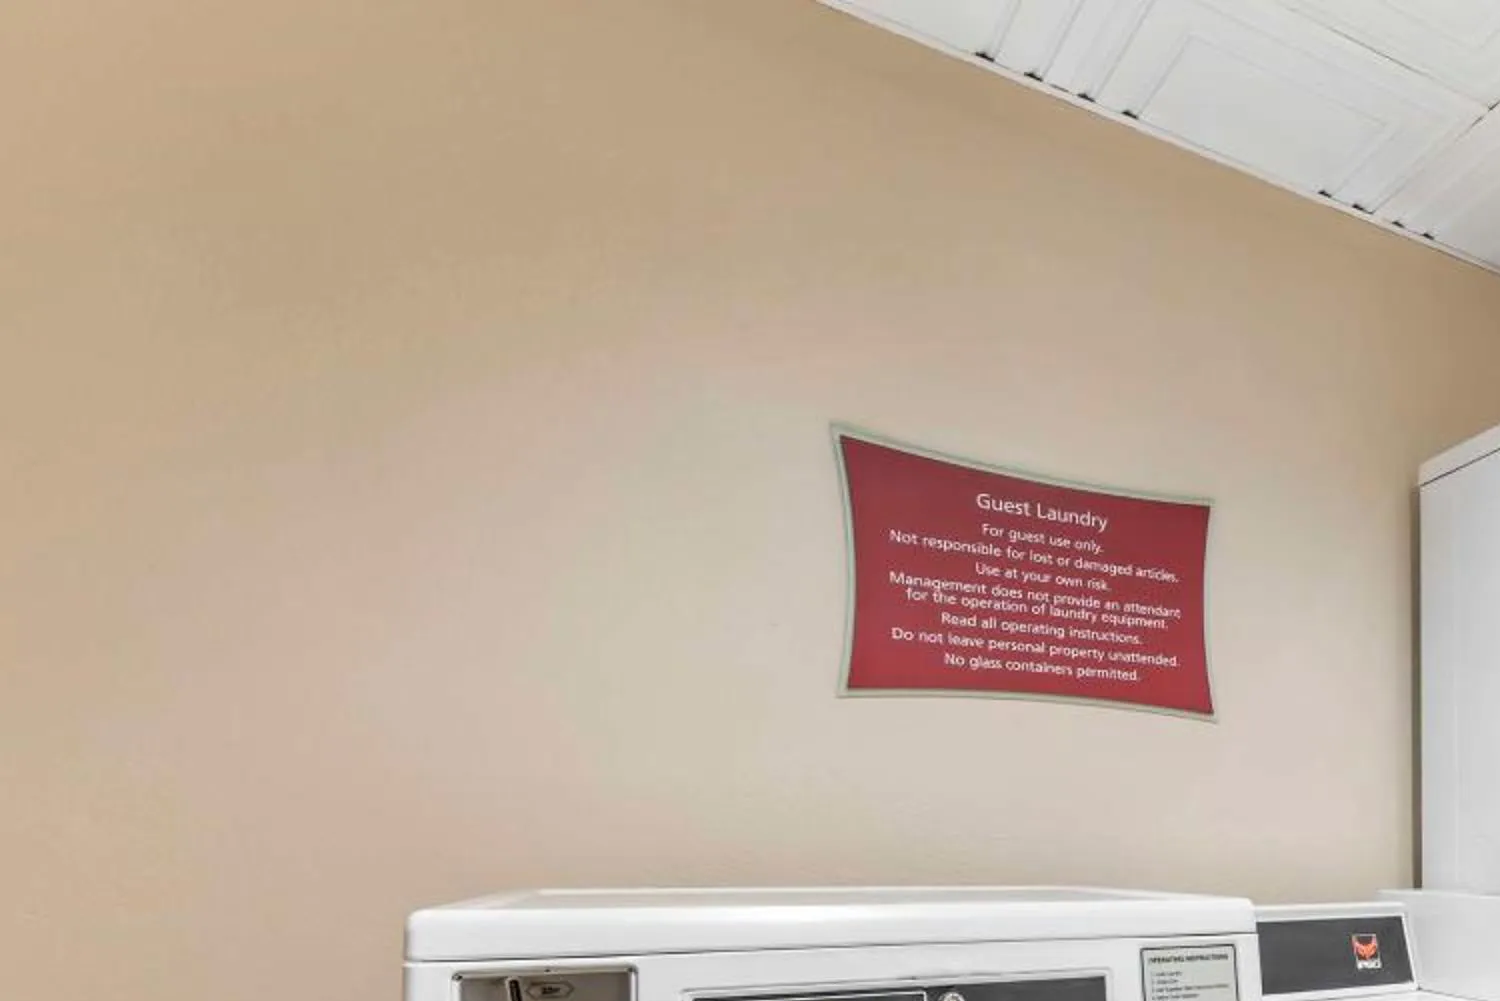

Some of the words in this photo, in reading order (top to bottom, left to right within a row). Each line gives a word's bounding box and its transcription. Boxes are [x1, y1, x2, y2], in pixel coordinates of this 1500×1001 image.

[976, 493, 1031, 517] Guest
[1036, 502, 1108, 532] Laundry
[889, 529, 917, 545] Not
[922, 535, 1002, 557] responsible
[1006, 546, 1024, 560] for
[1029, 549, 1053, 565] lost
[1057, 557, 1070, 567] or
[1074, 556, 1133, 577] damaged
[1136, 567, 1180, 583] articles.
[982, 523, 1004, 537] For
[1008, 529, 1045, 544] guest
[1050, 536, 1070, 548] use
[1075, 539, 1104, 555] only.
[889, 570, 987, 594] Management
[991, 585, 1022, 599] does
[1027, 590, 1049, 602] not
[1053, 594, 1100, 609] provide
[1104, 601, 1120, 610] an
[975, 561, 1000, 577] Use
[1005, 567, 1018, 580] at
[1021, 571, 1052, 583] your
[1056, 575, 1082, 587] own
[1087, 578, 1111, 592] risk.
[906, 587, 928, 601] for
[932, 591, 956, 605] the
[961, 597, 1027, 613] operation
[1031, 603, 1047, 615] of
[1050, 605, 1097, 624] laundry
[1101, 613, 1168, 629] equipment.
[891, 627, 914, 641] Do
[919, 632, 943, 644] not
[948, 633, 985, 648] leave
[988, 639, 1045, 653] personal
[1049, 645, 1105, 662] property
[1108, 651, 1180, 667] unattended.
[941, 611, 977, 627] Read
[981, 616, 997, 629] all
[1001, 620, 1065, 638] operating
[1069, 626, 1142, 645] instructions.
[944, 653, 965, 666] No
[969, 655, 1002, 671] glass
[1005, 660, 1073, 676] containers
